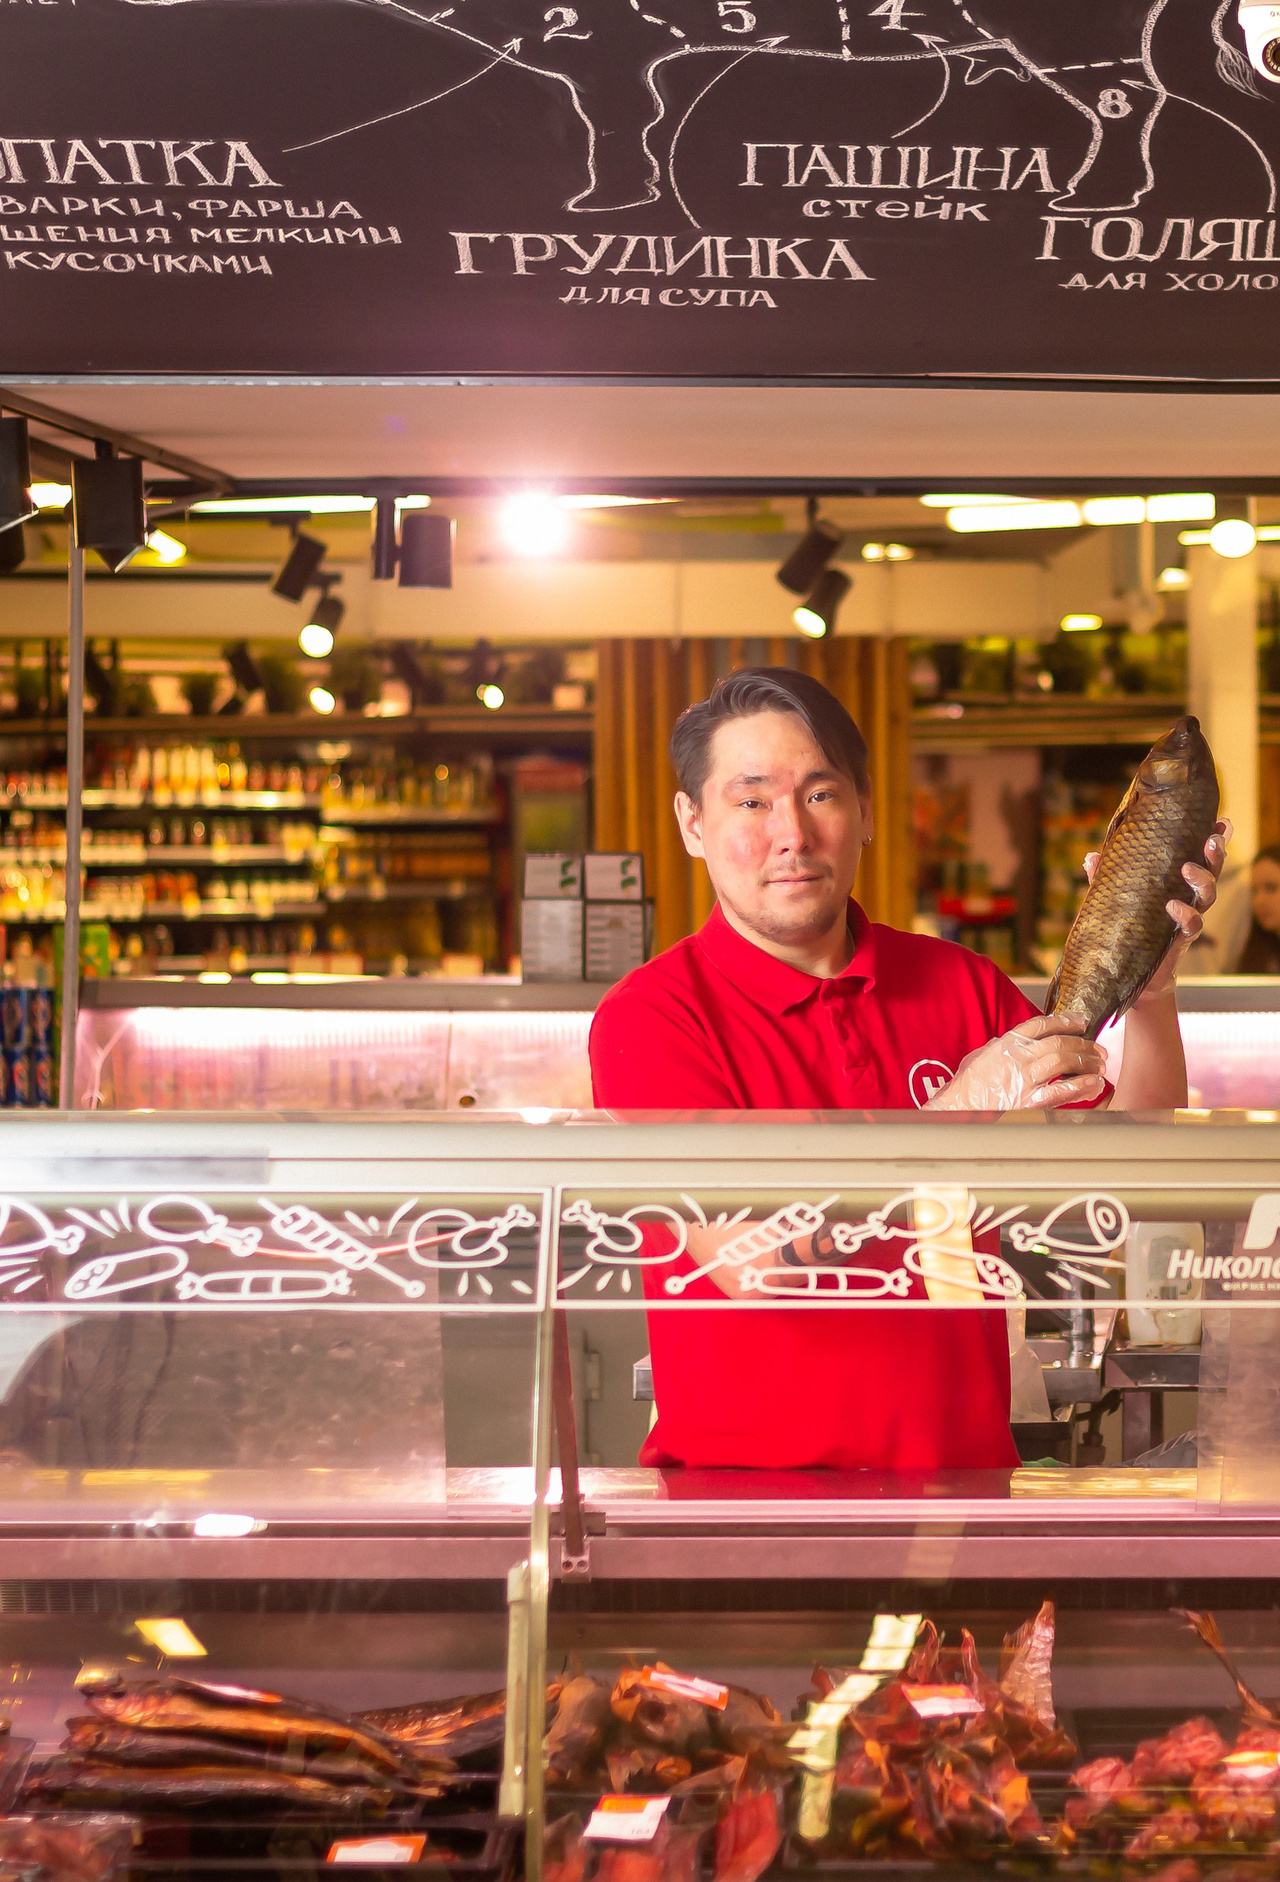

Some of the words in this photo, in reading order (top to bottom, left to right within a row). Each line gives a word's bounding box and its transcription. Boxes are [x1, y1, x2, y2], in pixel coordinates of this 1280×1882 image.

[544, 7, 592, 43] 2
[718, 0, 757, 33] 5
[868, 0, 926, 31] 4
[1098, 88, 1135, 118] 8
[0, 137, 284, 188] ПАТКА
[738, 142, 1061, 193] ПАШИНА
[0, 194, 182, 221] ВАРКИ,
[188, 199, 363, 219] ФАРША
[0, 224, 172, 244] ШЕНИЯ
[190, 226, 402, 245] МЕЛКИМИ
[3, 250, 273, 275] КУСОЧКАМИ
[448, 231, 876, 281] ГРУДИНКА
[1058, 272, 1148, 291] ДЛЯ
[558, 286, 651, 306] ДЛЯ
[657, 287, 779, 309] СУПА
